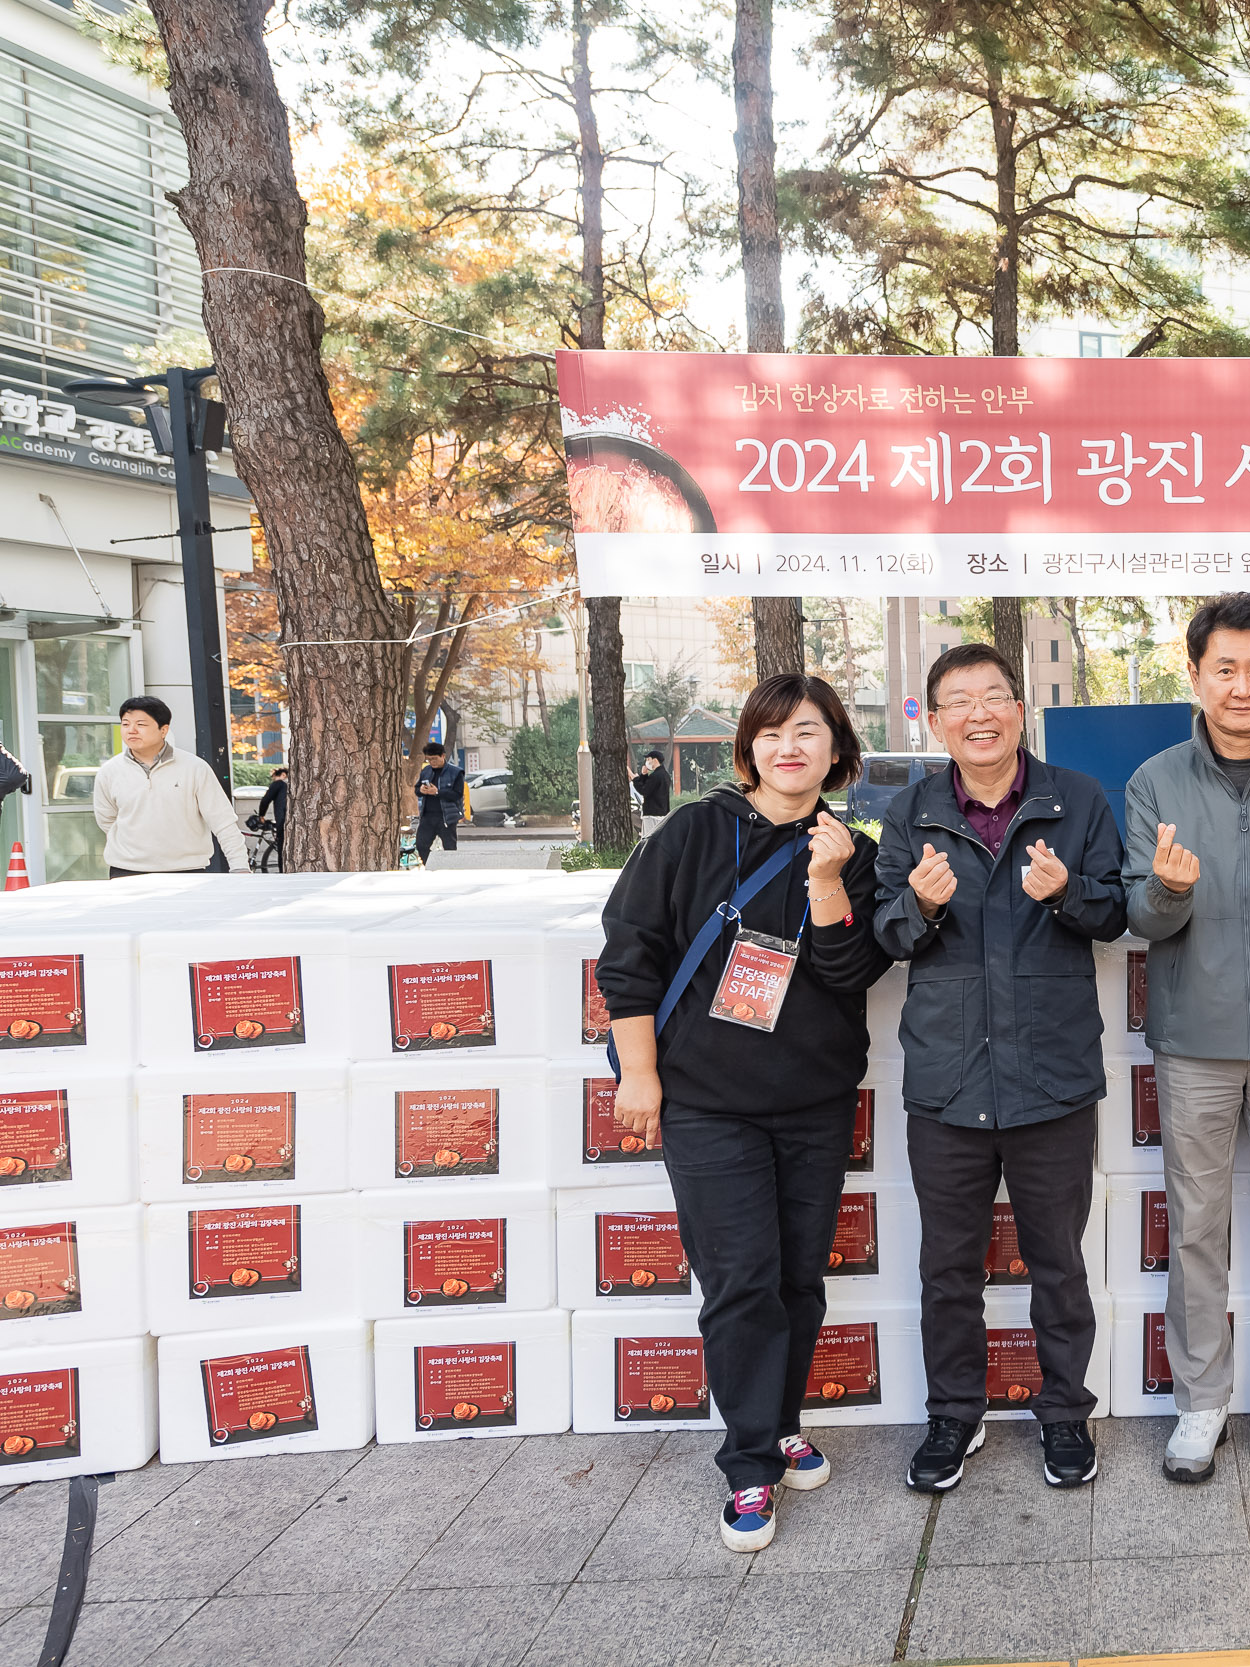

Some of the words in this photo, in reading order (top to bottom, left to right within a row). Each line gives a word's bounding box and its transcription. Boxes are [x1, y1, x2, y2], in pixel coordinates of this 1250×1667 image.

[734, 382, 781, 412] 김치
[789, 383, 895, 414] 한상자로
[899, 384, 976, 414] 전하는
[981, 385, 1034, 414] 안부
[0, 389, 80, 439] 학교
[88, 452, 154, 477] Gwangjin
[735, 438, 875, 493] 2024
[889, 431, 1052, 505] 제2회
[1077, 431, 1205, 506] 광진
[701, 553, 741, 575] 일시
[776, 554, 830, 572] 2024.
[839, 555, 867, 572] 11.
[876, 553, 934, 575] 12(화)
[966, 553, 1009, 575] 장소
[1042, 552, 1233, 575] 광진구시설관리공단
[204, 974, 222, 982] 제2회
[223, 974, 238, 982] 광진
[238, 972, 259, 981] 사랑의
[259, 970, 287, 979] 김장축제
[402, 977, 419, 985] 제2회
[419, 976, 433, 984] 광진
[433, 975, 453, 983] 사랑의
[453, 973, 479, 982] 김장축제
[732, 964, 782, 989] 담당직원
[728, 980, 776, 1002] STAFF
[198, 1107, 216, 1115] 제2회
[217, 1107, 231, 1115] 광진
[232, 1106, 253, 1114] 사랑의
[253, 1105, 281, 1114] 김장축제
[636, 1224, 654, 1232] 사랑의
[417, 1233, 434, 1241] 제2회
[435, 1233, 448, 1241] 광진
[448, 1232, 467, 1240] 사랑의
[468, 1231, 493, 1239] 김장축제
[458, 1356, 477, 1364] 사랑의
[478, 1355, 502, 1363] 김장축제
[627, 1349, 644, 1357] 제2회
[246, 1357, 265, 1365] 2024
[216, 1369, 234, 1378] 제2회
[234, 1367, 249, 1376] 광진
[248, 1363, 269, 1374] 사랑의
[269, 1360, 296, 1371] 김장축제
